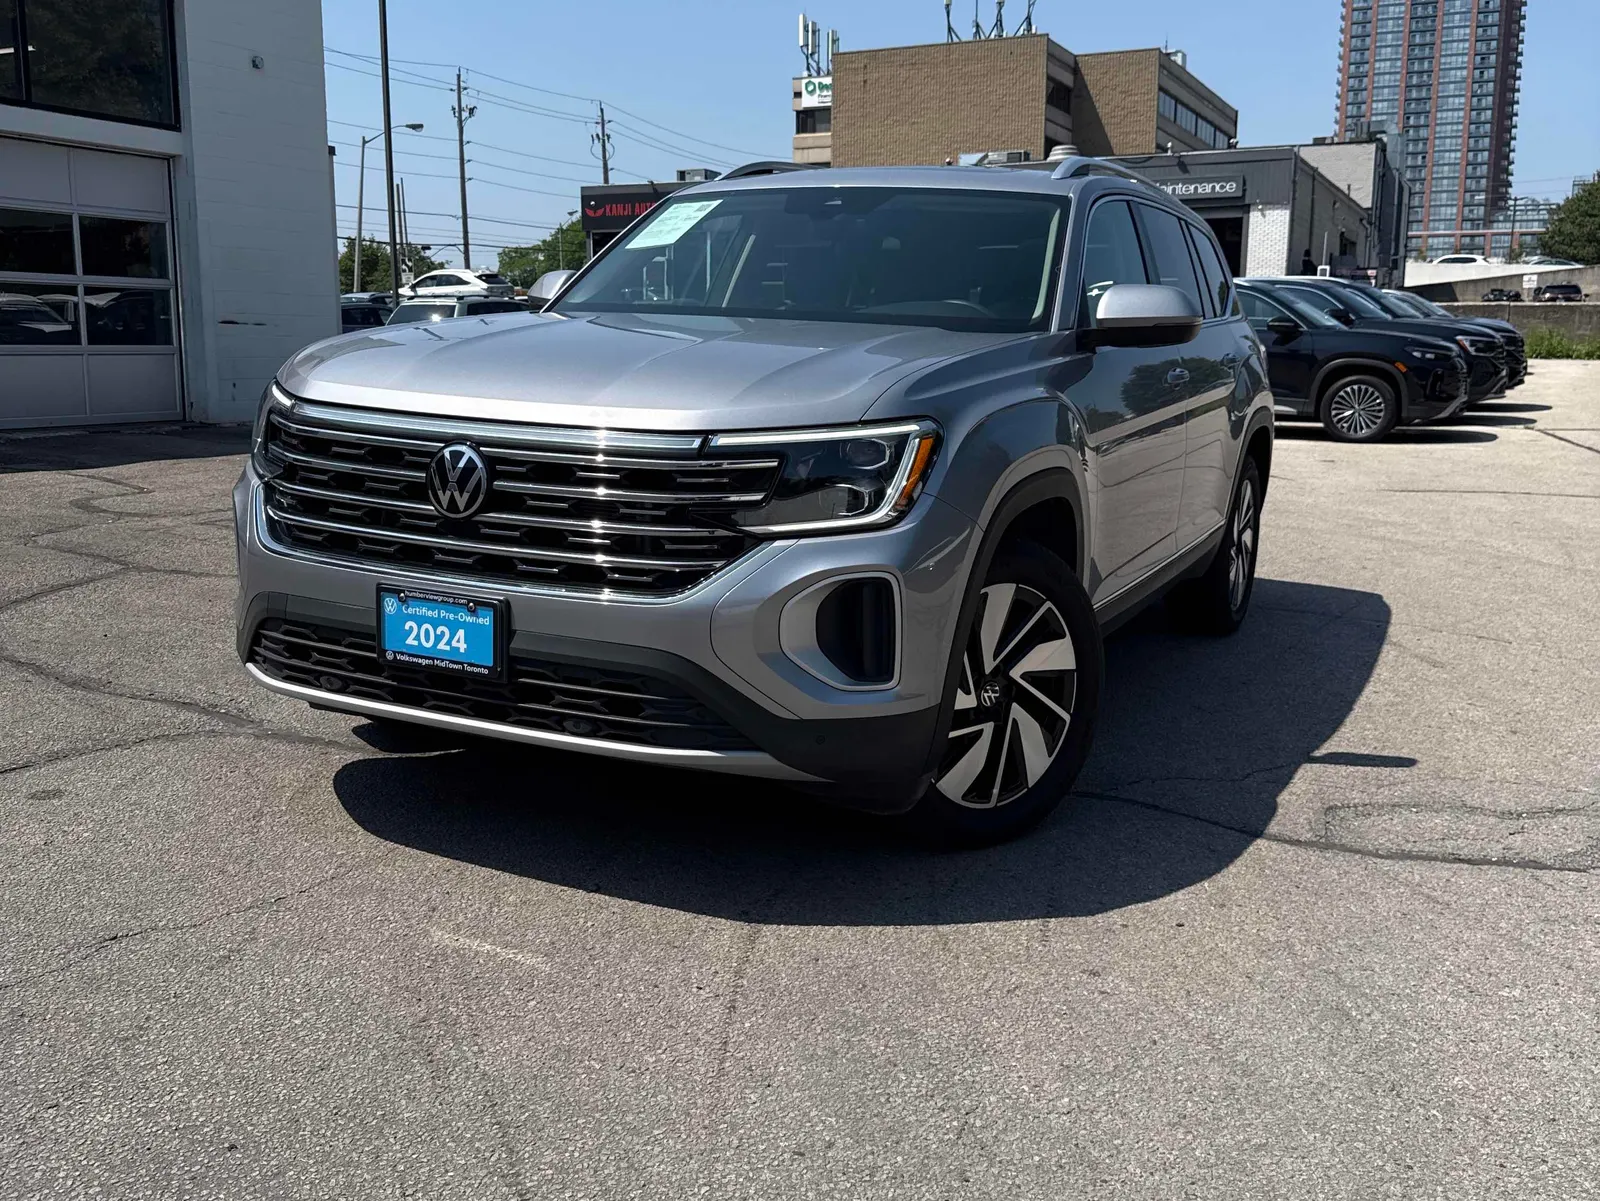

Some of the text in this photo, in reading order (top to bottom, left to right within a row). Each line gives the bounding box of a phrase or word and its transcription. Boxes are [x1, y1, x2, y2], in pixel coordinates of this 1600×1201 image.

[1156, 181, 1237, 195] aintenance
[605, 203, 632, 216] KANJI
[404, 590, 468, 605] humberviewgroup.com
[402, 604, 490, 625] Certified Pre-Owned
[404, 621, 468, 653] 2024
[396, 653, 434, 666] Volkswagen
[434, 659, 463, 670] MidTown
[463, 664, 489, 674] Toronto
